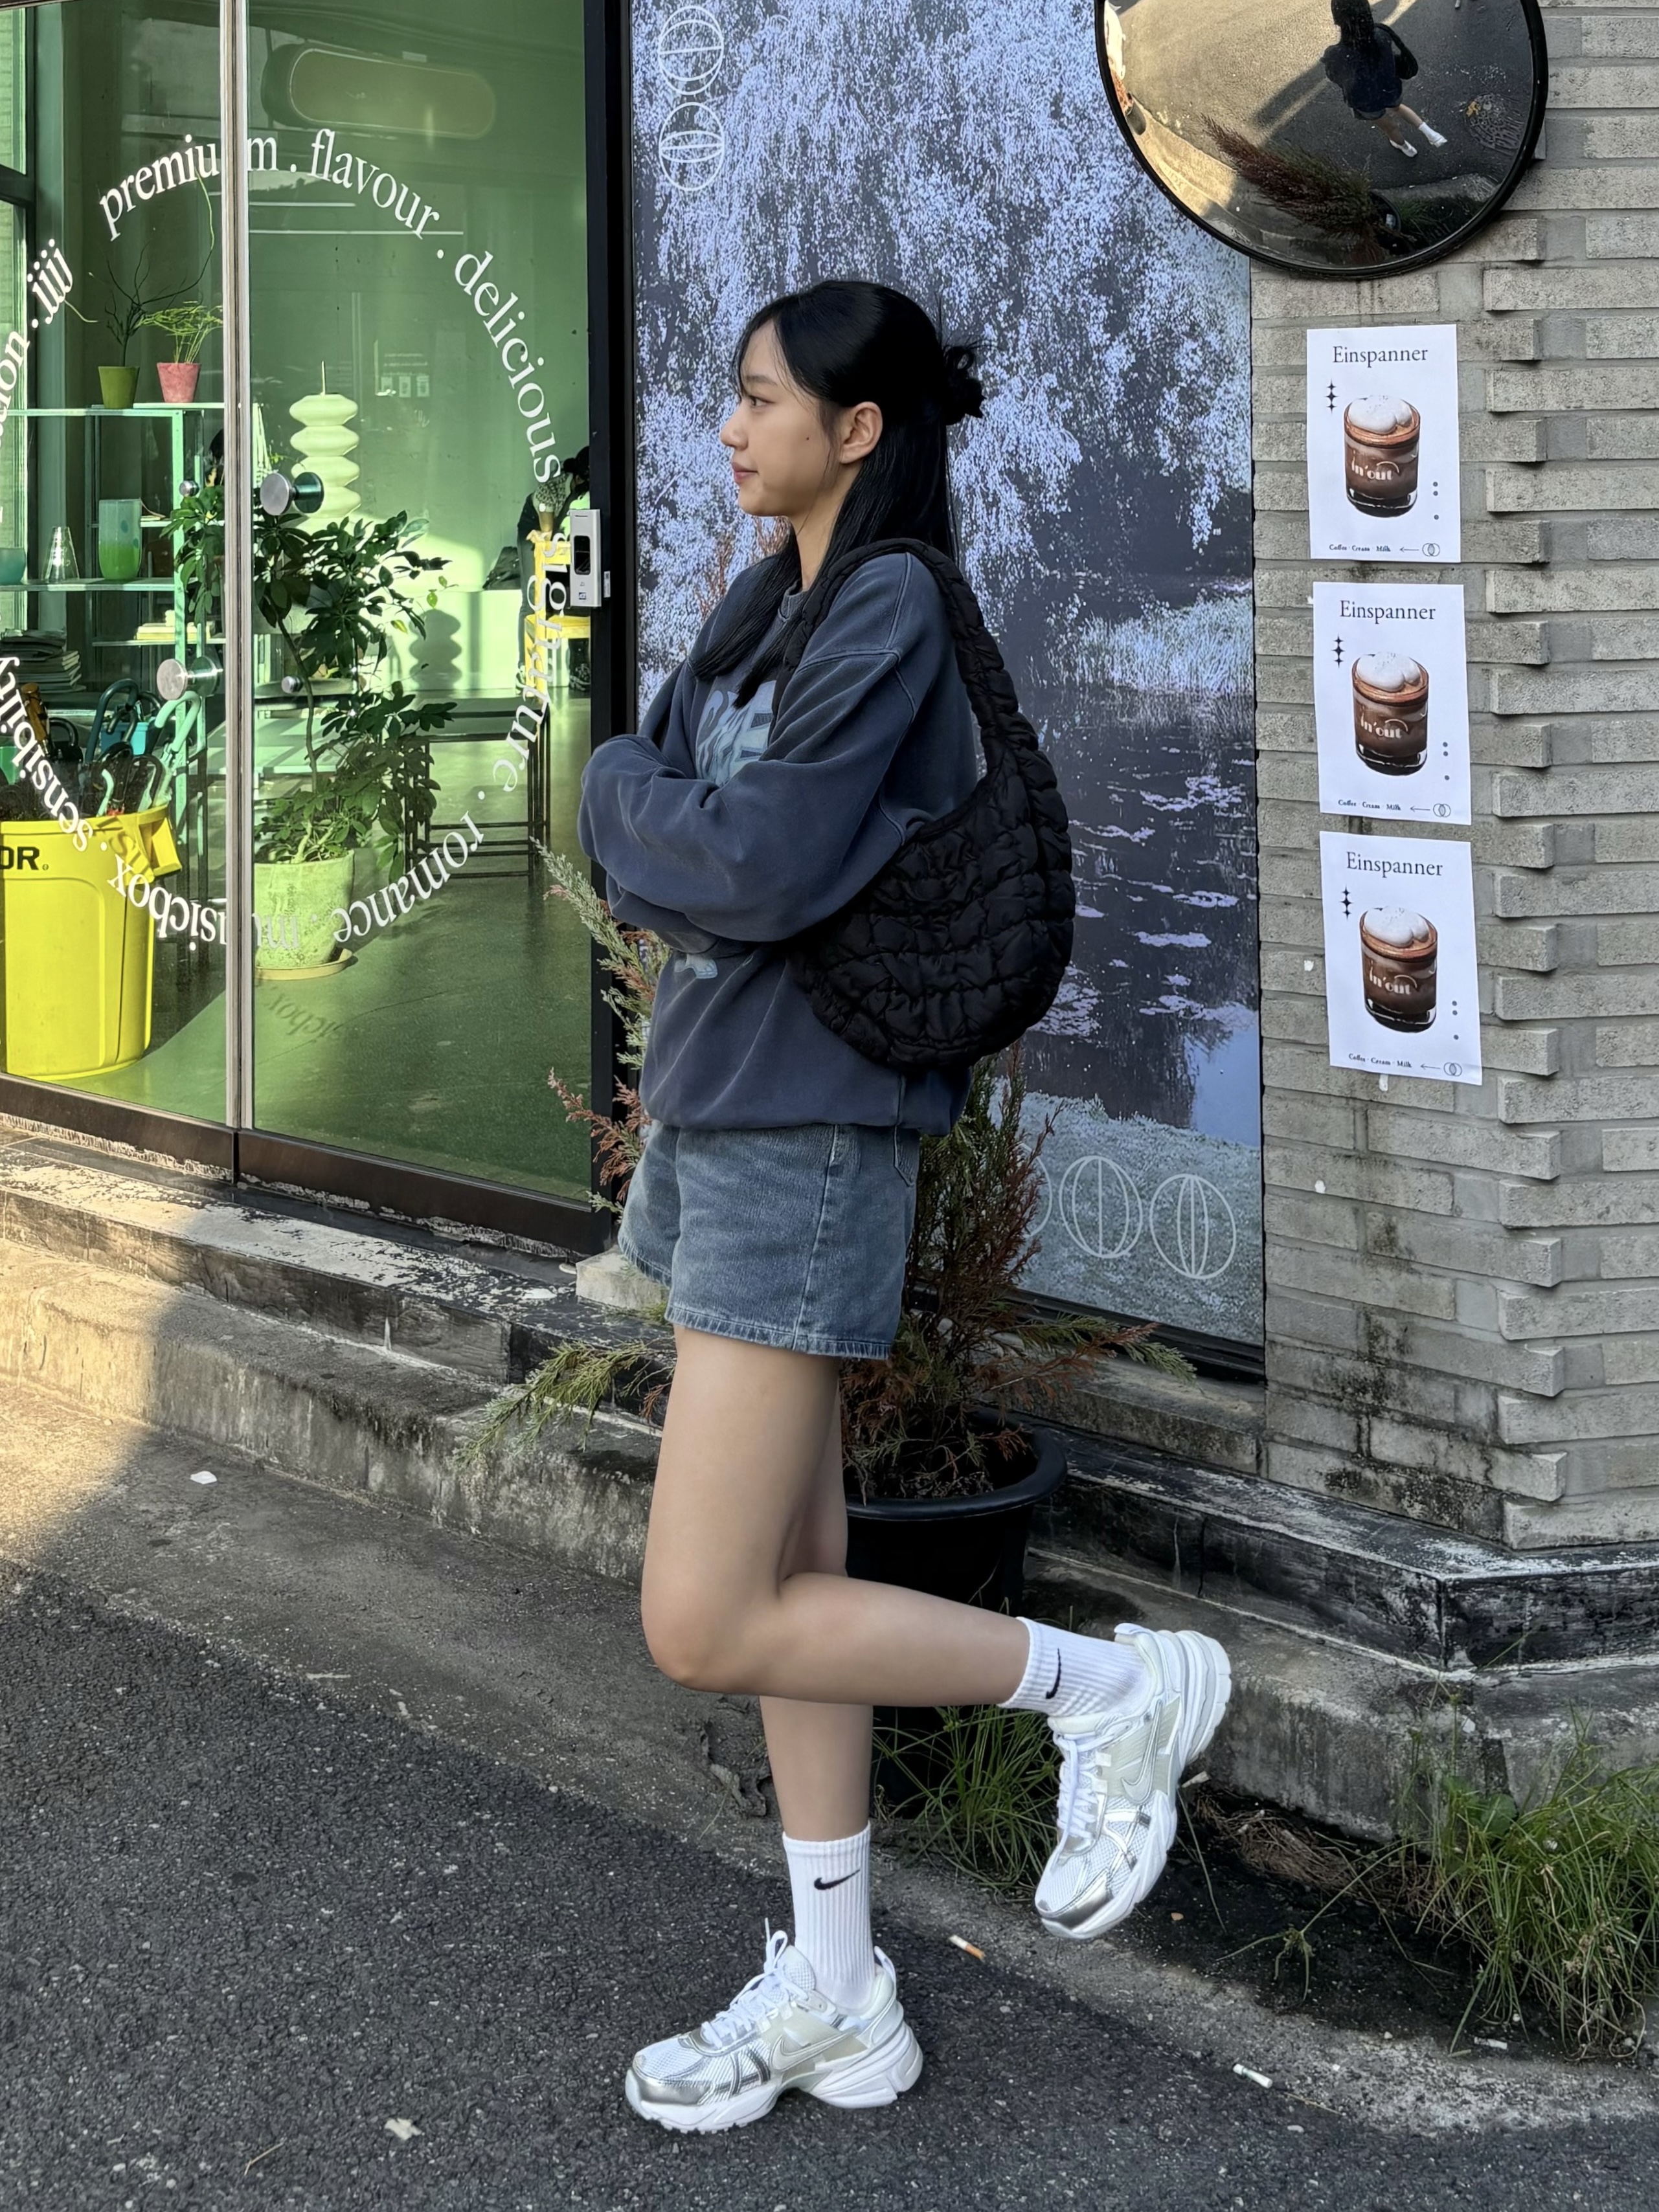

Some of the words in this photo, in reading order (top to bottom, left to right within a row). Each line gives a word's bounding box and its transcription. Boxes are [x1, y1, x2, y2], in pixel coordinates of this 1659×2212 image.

[99, 133, 279, 241] premium
[307, 128, 440, 240] flavour
[455, 250, 561, 484] delicious
[1333, 345, 1428, 368] Einspanner
[492, 532, 570, 792] signature
[1340, 599, 1436, 625] Einspanner
[330, 810, 484, 943] romance
[1346, 851, 1443, 878] Einspanner
[1397, 1060, 1412, 1068] Milk
